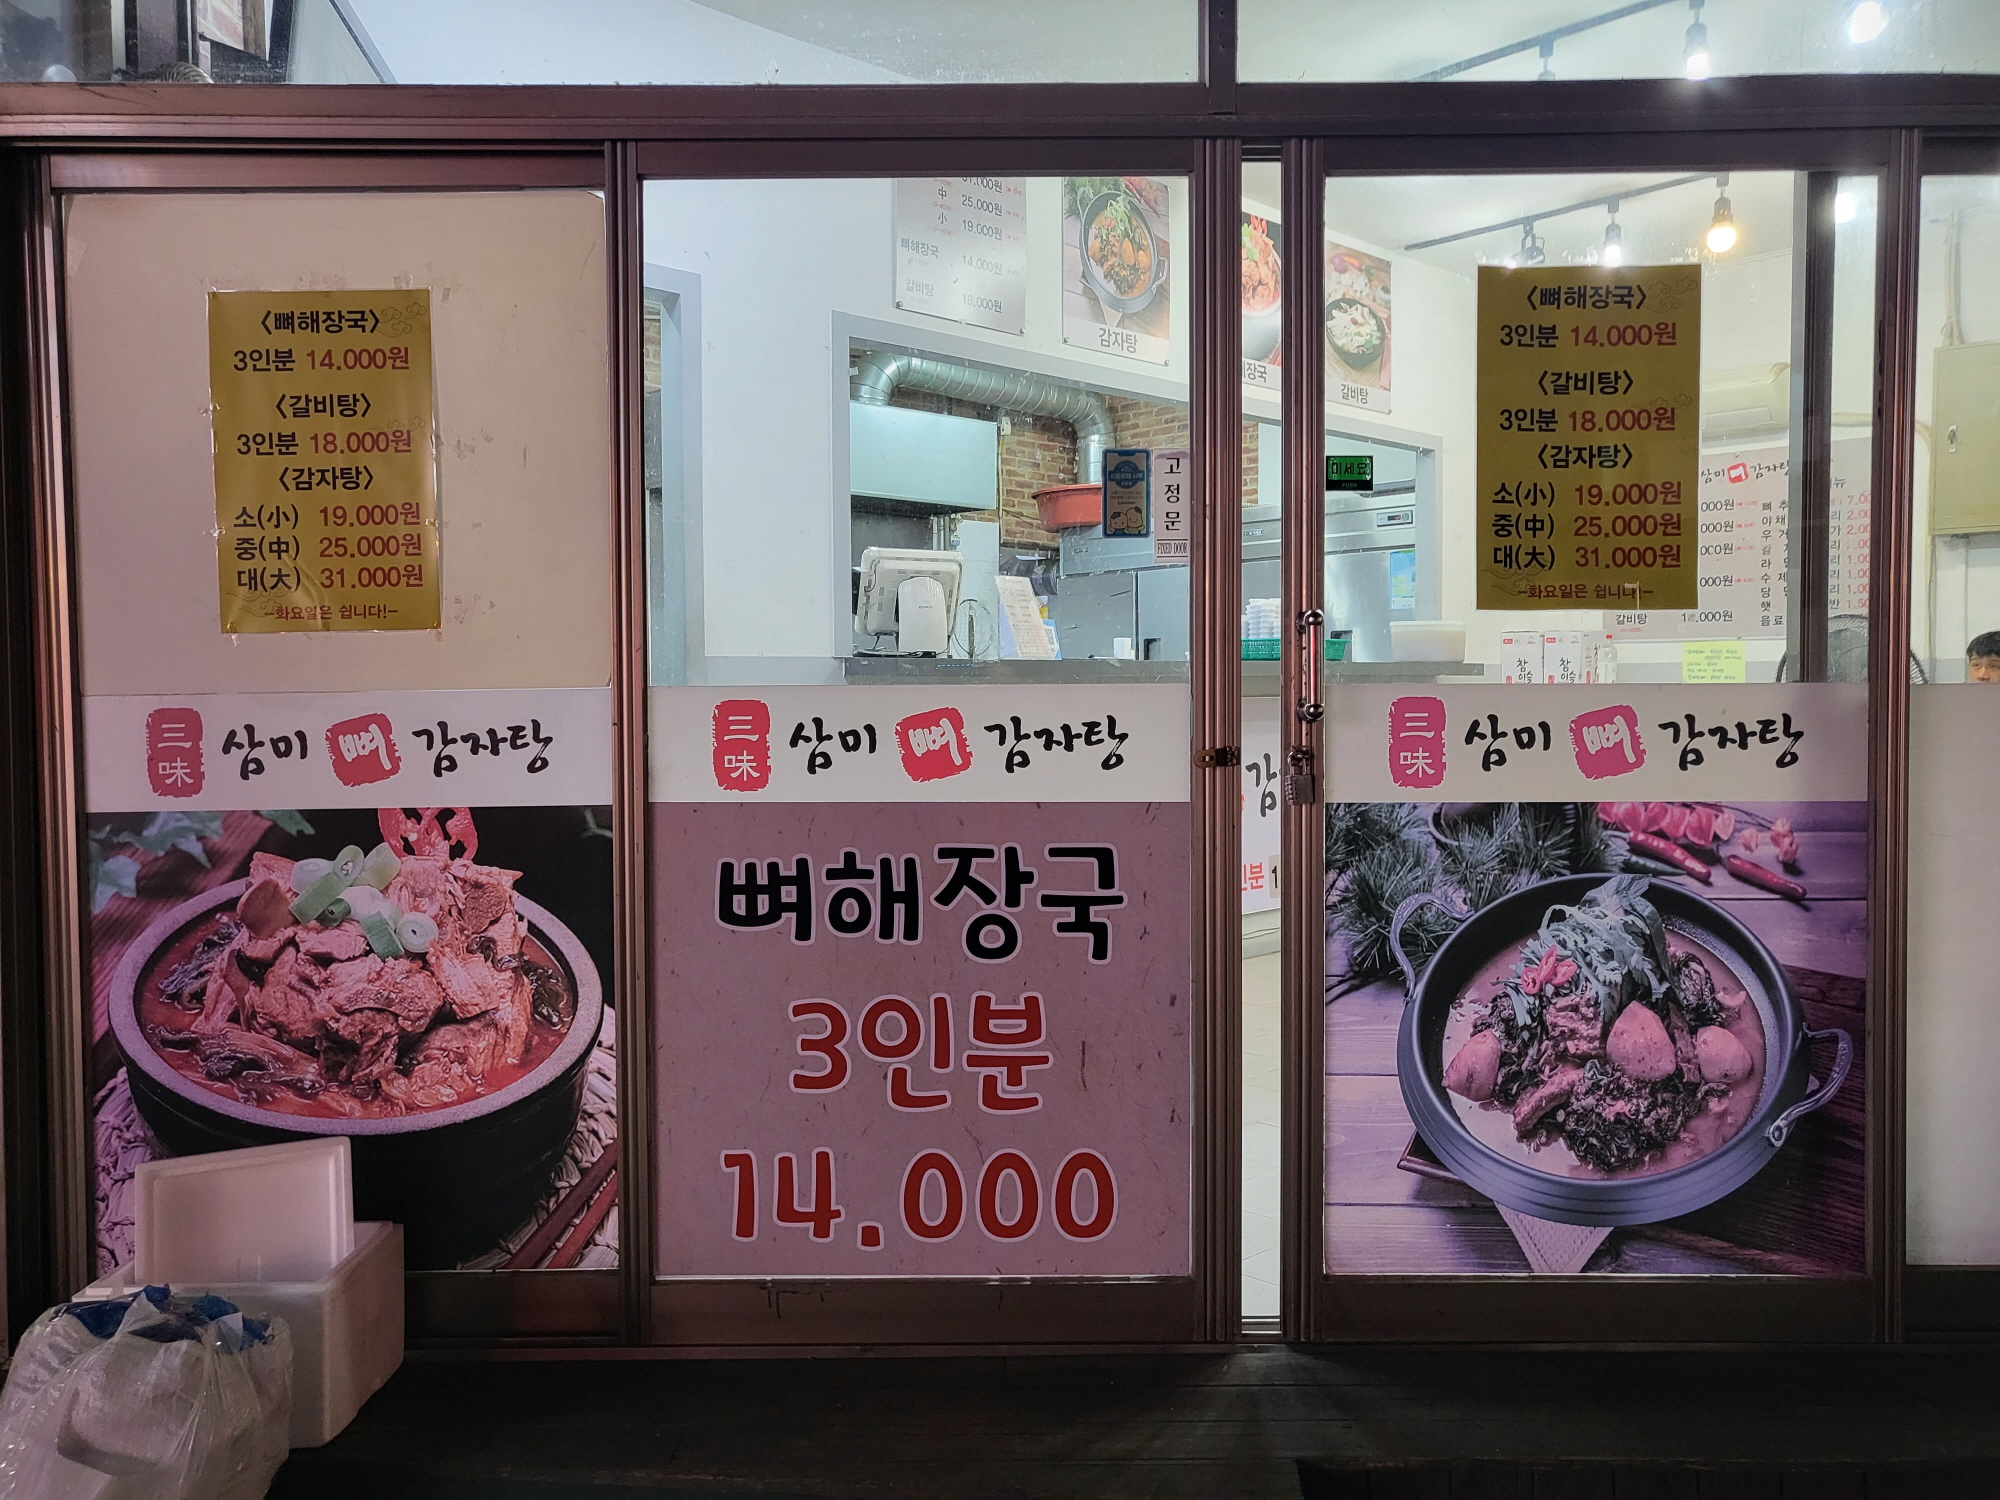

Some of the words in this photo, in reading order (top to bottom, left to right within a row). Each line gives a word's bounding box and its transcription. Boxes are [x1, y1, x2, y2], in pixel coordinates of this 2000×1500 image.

[938, 186, 947, 201] 中
[961, 194, 1003, 217] 25.000원
[938, 211, 948, 225] 小
[962, 219, 1003, 241] 19.000원
[900, 237, 939, 259] 뼈해장국
[962, 254, 1003, 276] 14.000원
[962, 293, 1002, 314] 18.000원
[1098, 327, 1138, 354] 감자탕
[1500, 324, 1559, 348] 3인분
[1570, 322, 1677, 348] 14.000원
[233, 348, 295, 372] 3인분
[306, 346, 410, 371] 14.000원
[1341, 383, 1369, 405] 갈비탕
[1500, 408, 1558, 433] 3인분
[1568, 407, 1676, 432] 18.000원
[236, 431, 299, 456] 3인분
[310, 430, 412, 454] 18.000원
[1331, 462, 1368, 476] 미세요
[1700, 468, 1726, 484] 삼미
[1492, 482, 1555, 508] 소(小)
[1574, 480, 1682, 507] 19.000원
[233, 504, 299, 529] 소(小)
[319, 502, 421, 527] 19.000원
[1492, 514, 1555, 539] 중(中)
[1574, 514, 1682, 538] 25.000원
[234, 535, 300, 561] 중(中)
[319, 534, 422, 559] 25.000원
[1157, 542, 1172, 554] FIXED
[1174, 542, 1188, 554] DOOR
[1493, 546, 1556, 571] 대(大)
[1575, 544, 1682, 569] 31.000원
[237, 566, 301, 592] 대(大)
[320, 564, 424, 590] 31.000원
[1615, 612, 1648, 625] 갈비탕
[1516, 657, 1528, 672] 참
[1560, 656, 1572, 672] 참
[157, 723, 194, 788] 三味
[221, 724, 309, 781] 삼미
[412, 718, 553, 778] 감자탕
[723, 715, 760, 781] 三味
[790, 716, 878, 776] 삼미
[984, 714, 1129, 774] 감자탕
[1399, 712, 1437, 779] 三味
[1463, 713, 1552, 772] 삼미
[1658, 713, 1805, 772] 감자탕
[716, 843, 1126, 964] 뼈해장국
[790, 993, 1052, 1114] 3인분
[721, 1147, 1117, 1250] 14.000
